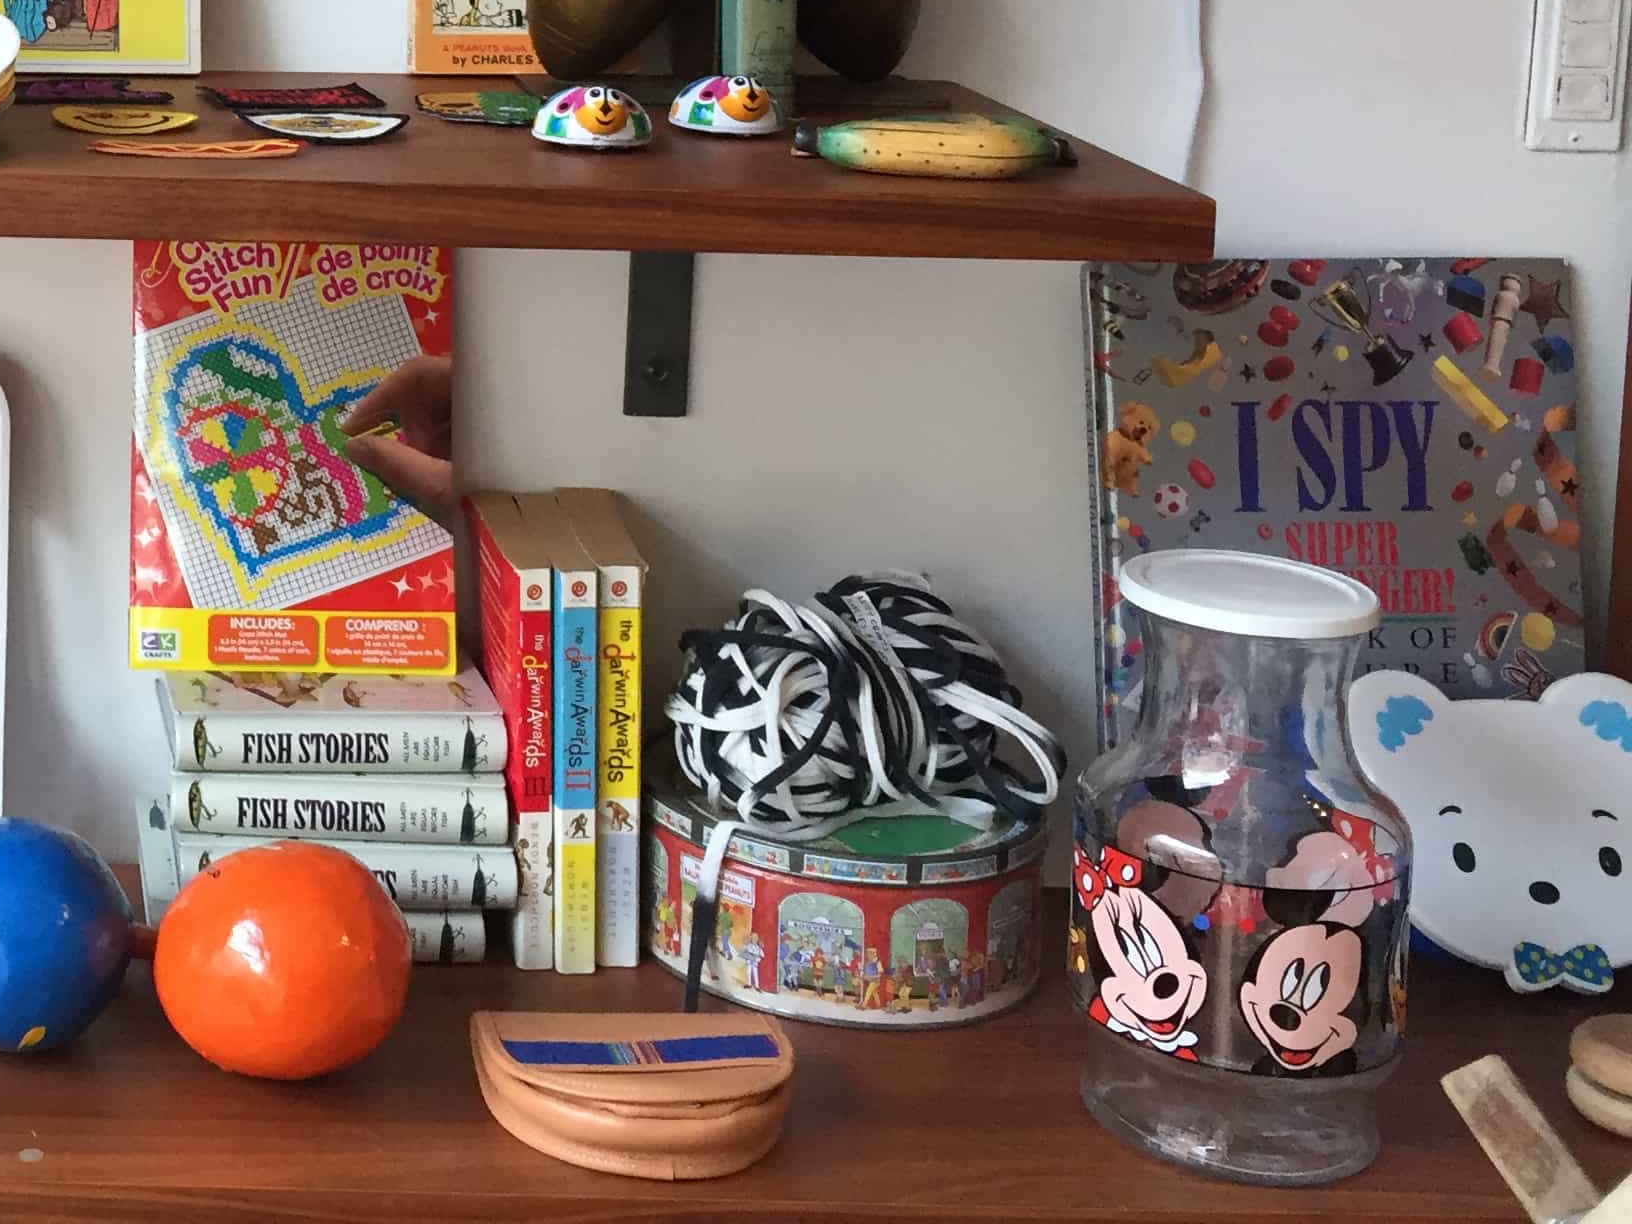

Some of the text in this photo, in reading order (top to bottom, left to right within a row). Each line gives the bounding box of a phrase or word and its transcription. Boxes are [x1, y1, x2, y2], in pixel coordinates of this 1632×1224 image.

[452, 54, 534, 67] by CHARLES
[184, 243, 276, 296] Stitch
[318, 248, 353, 276] de
[212, 273, 273, 313] Fun
[322, 267, 437, 304] de croix
[1230, 398, 1441, 513] I SPY
[1284, 520, 1399, 566] SUPER
[229, 616, 296, 630] INCLUDES:
[345, 619, 419, 632] COMPREND
[575, 626, 585, 645] the
[619, 620, 632, 642] the
[534, 634, 545, 652] the
[1410, 626, 1457, 649] OF
[242, 732, 390, 764] FISH STORIES
[565, 769, 592, 790] II
[237, 797, 386, 833] FISH STORIES
